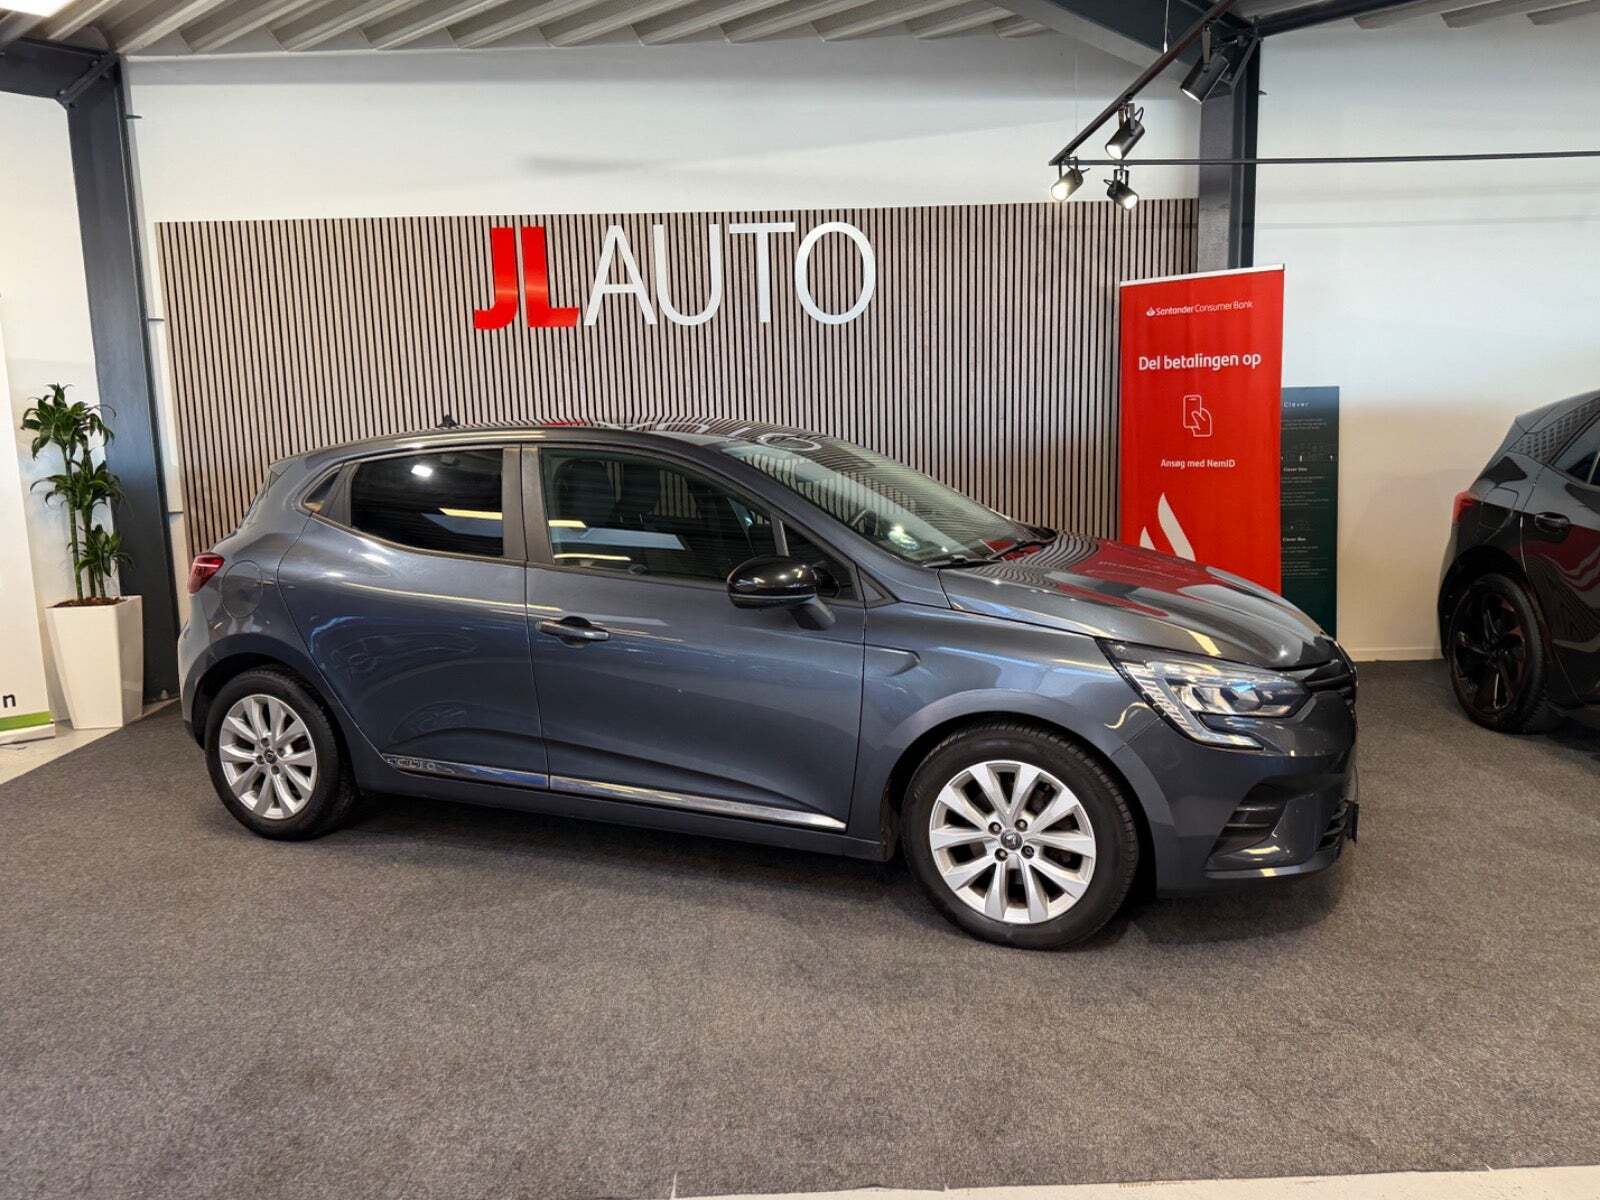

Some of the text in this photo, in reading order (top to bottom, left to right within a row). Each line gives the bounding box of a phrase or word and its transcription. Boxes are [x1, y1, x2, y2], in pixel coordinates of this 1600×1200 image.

[473, 221, 877, 330] JL AUTO
[1155, 300, 1254, 317] Santander Consumer Bank
[1138, 353, 1262, 371] Del betalingen op
[1160, 458, 1236, 469] Ansøg med NemID
